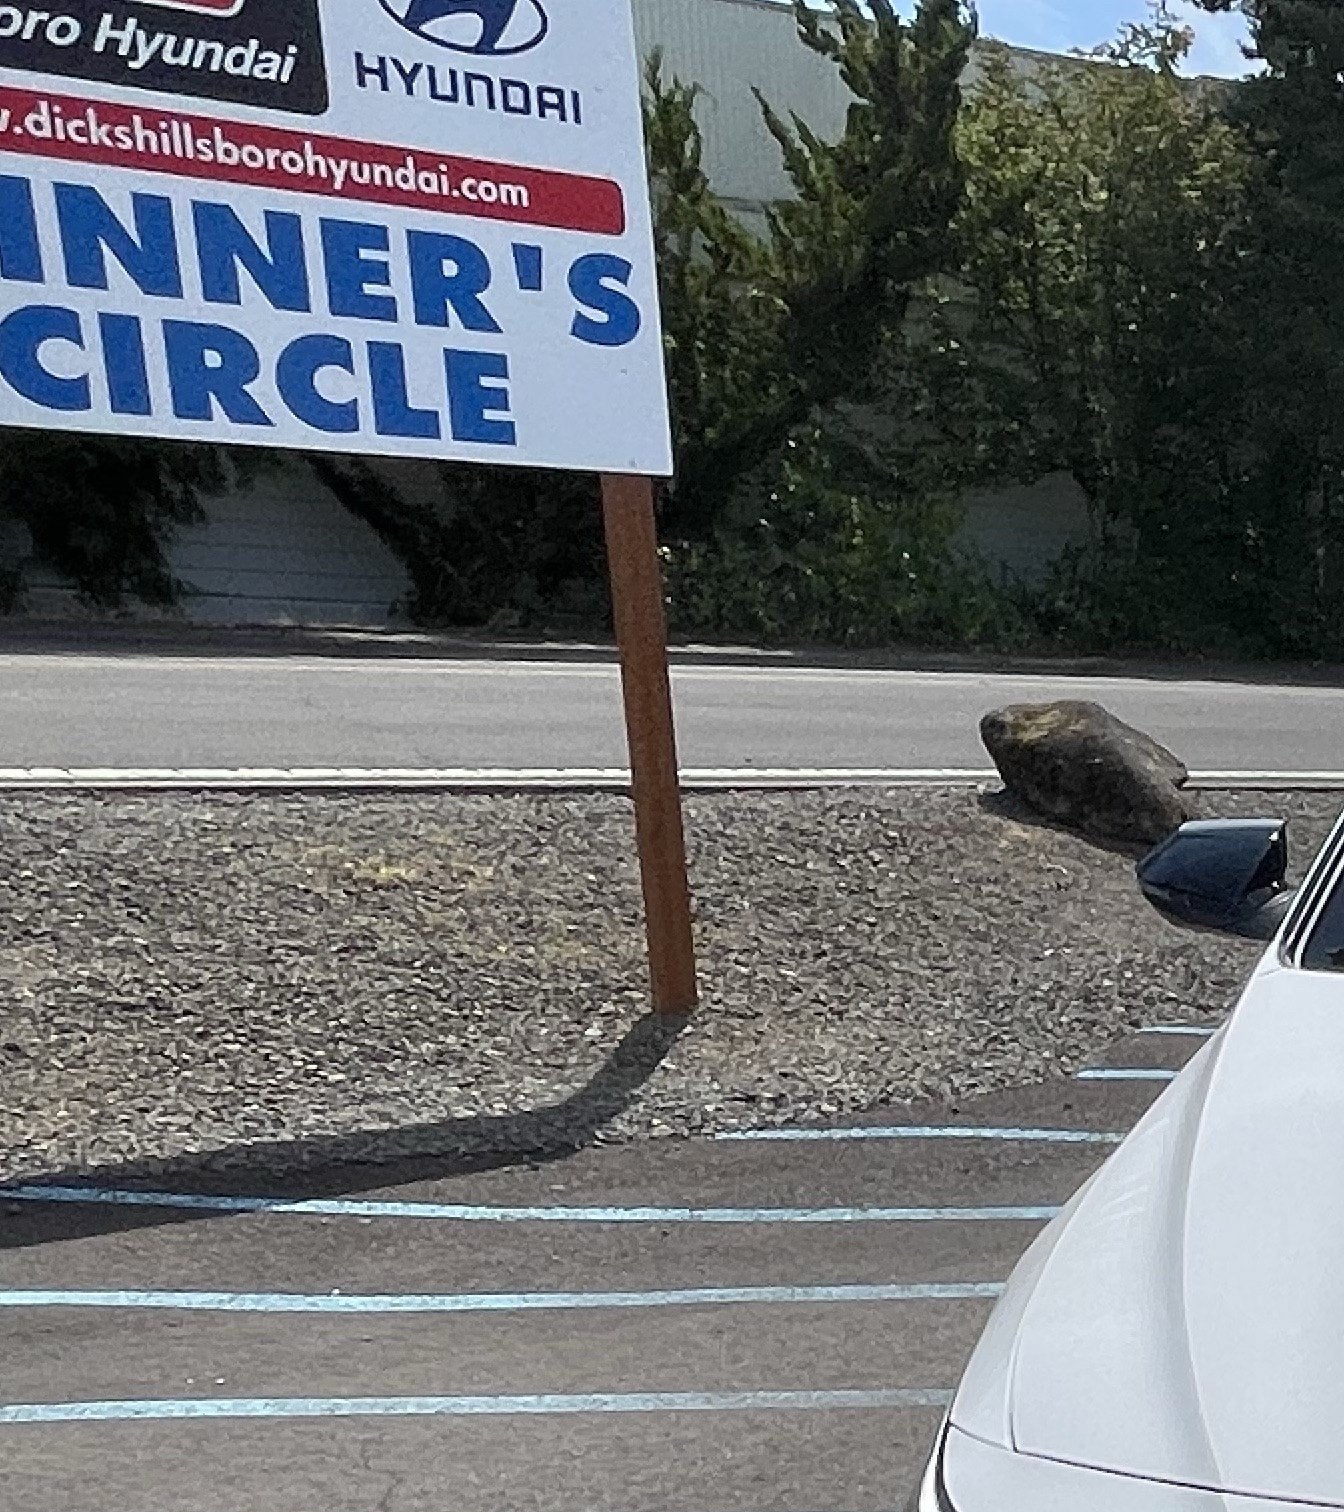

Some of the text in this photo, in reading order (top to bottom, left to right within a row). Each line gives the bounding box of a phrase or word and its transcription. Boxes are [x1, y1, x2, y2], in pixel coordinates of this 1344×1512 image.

[93, 12, 299, 84] Hyundai
[354, 51, 583, 125] HYUNDAI
[0, 304, 517, 447] CIRCLE
